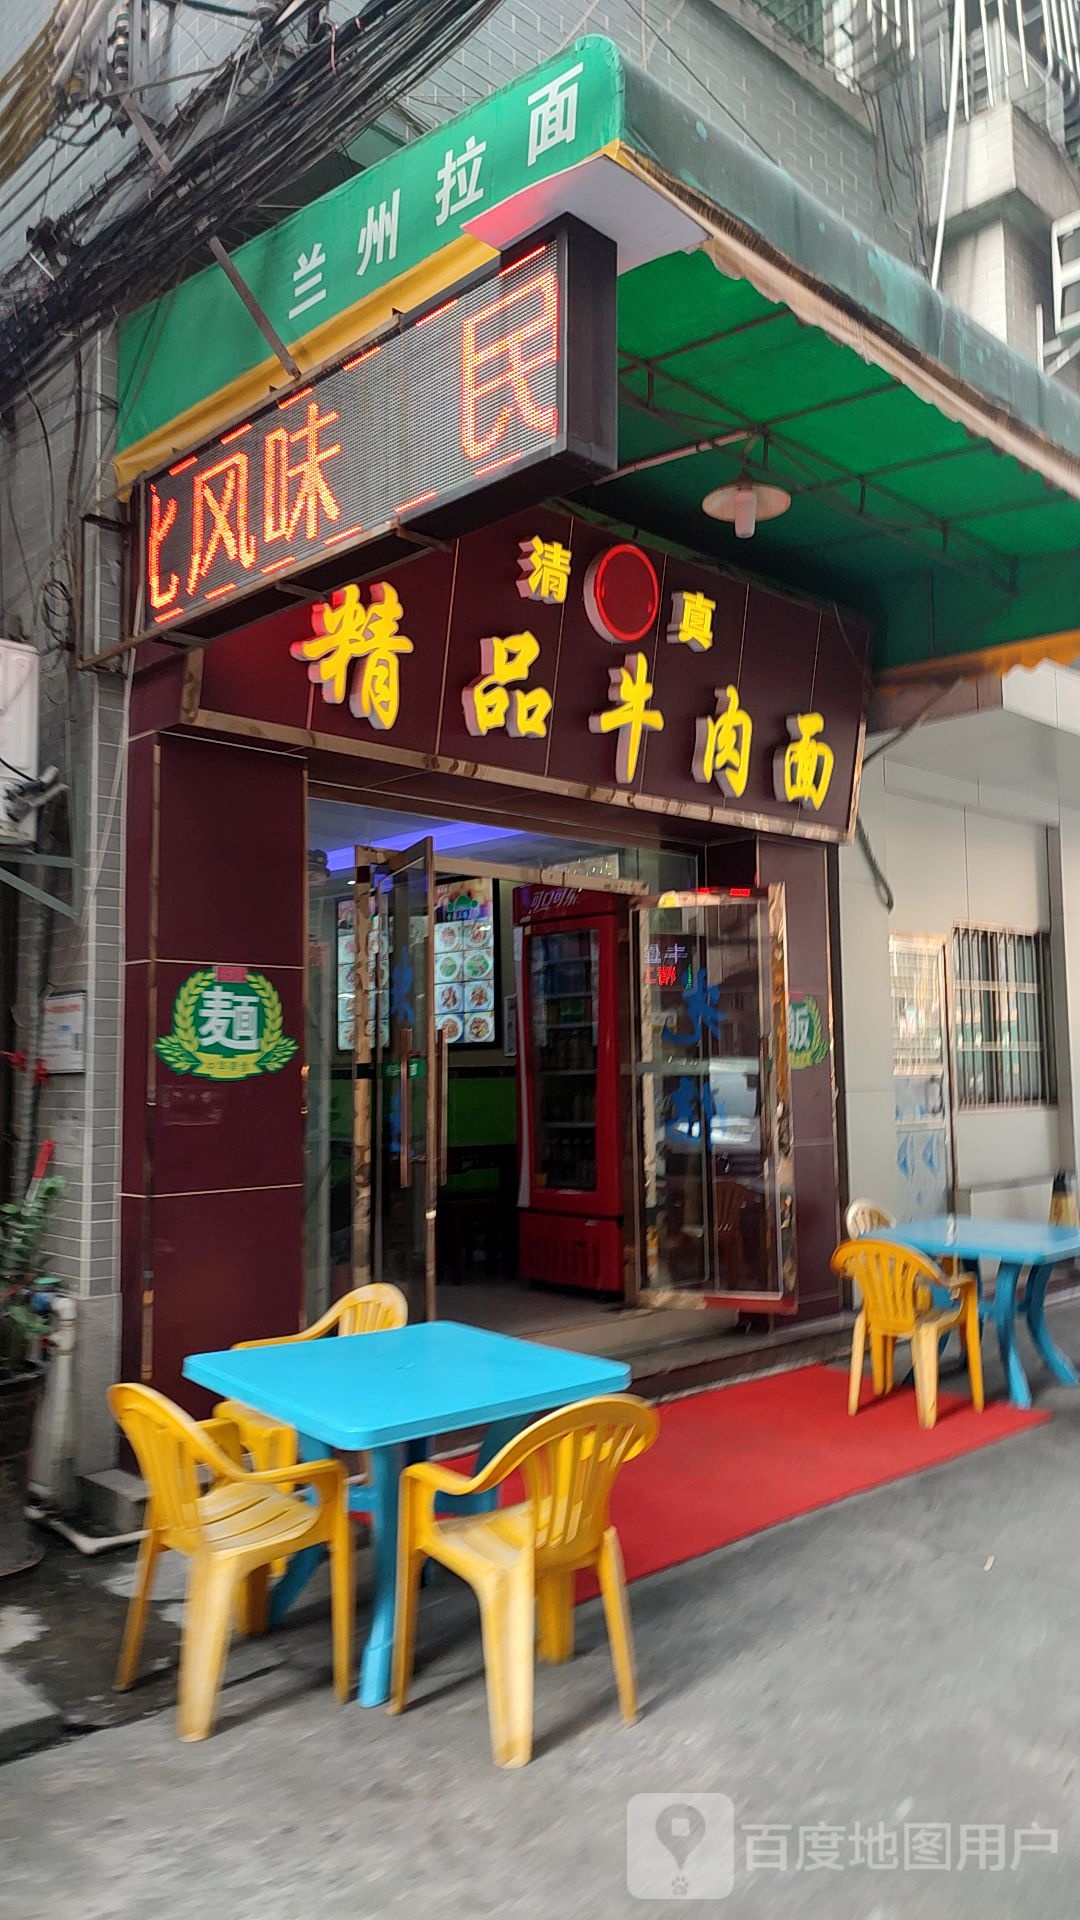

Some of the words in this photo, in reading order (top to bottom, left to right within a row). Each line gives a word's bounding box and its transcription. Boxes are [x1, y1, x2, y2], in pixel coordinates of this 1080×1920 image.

[288, 61, 584, 320] 兰州拉面
[291, 582, 835, 810] 精品牛肉面
